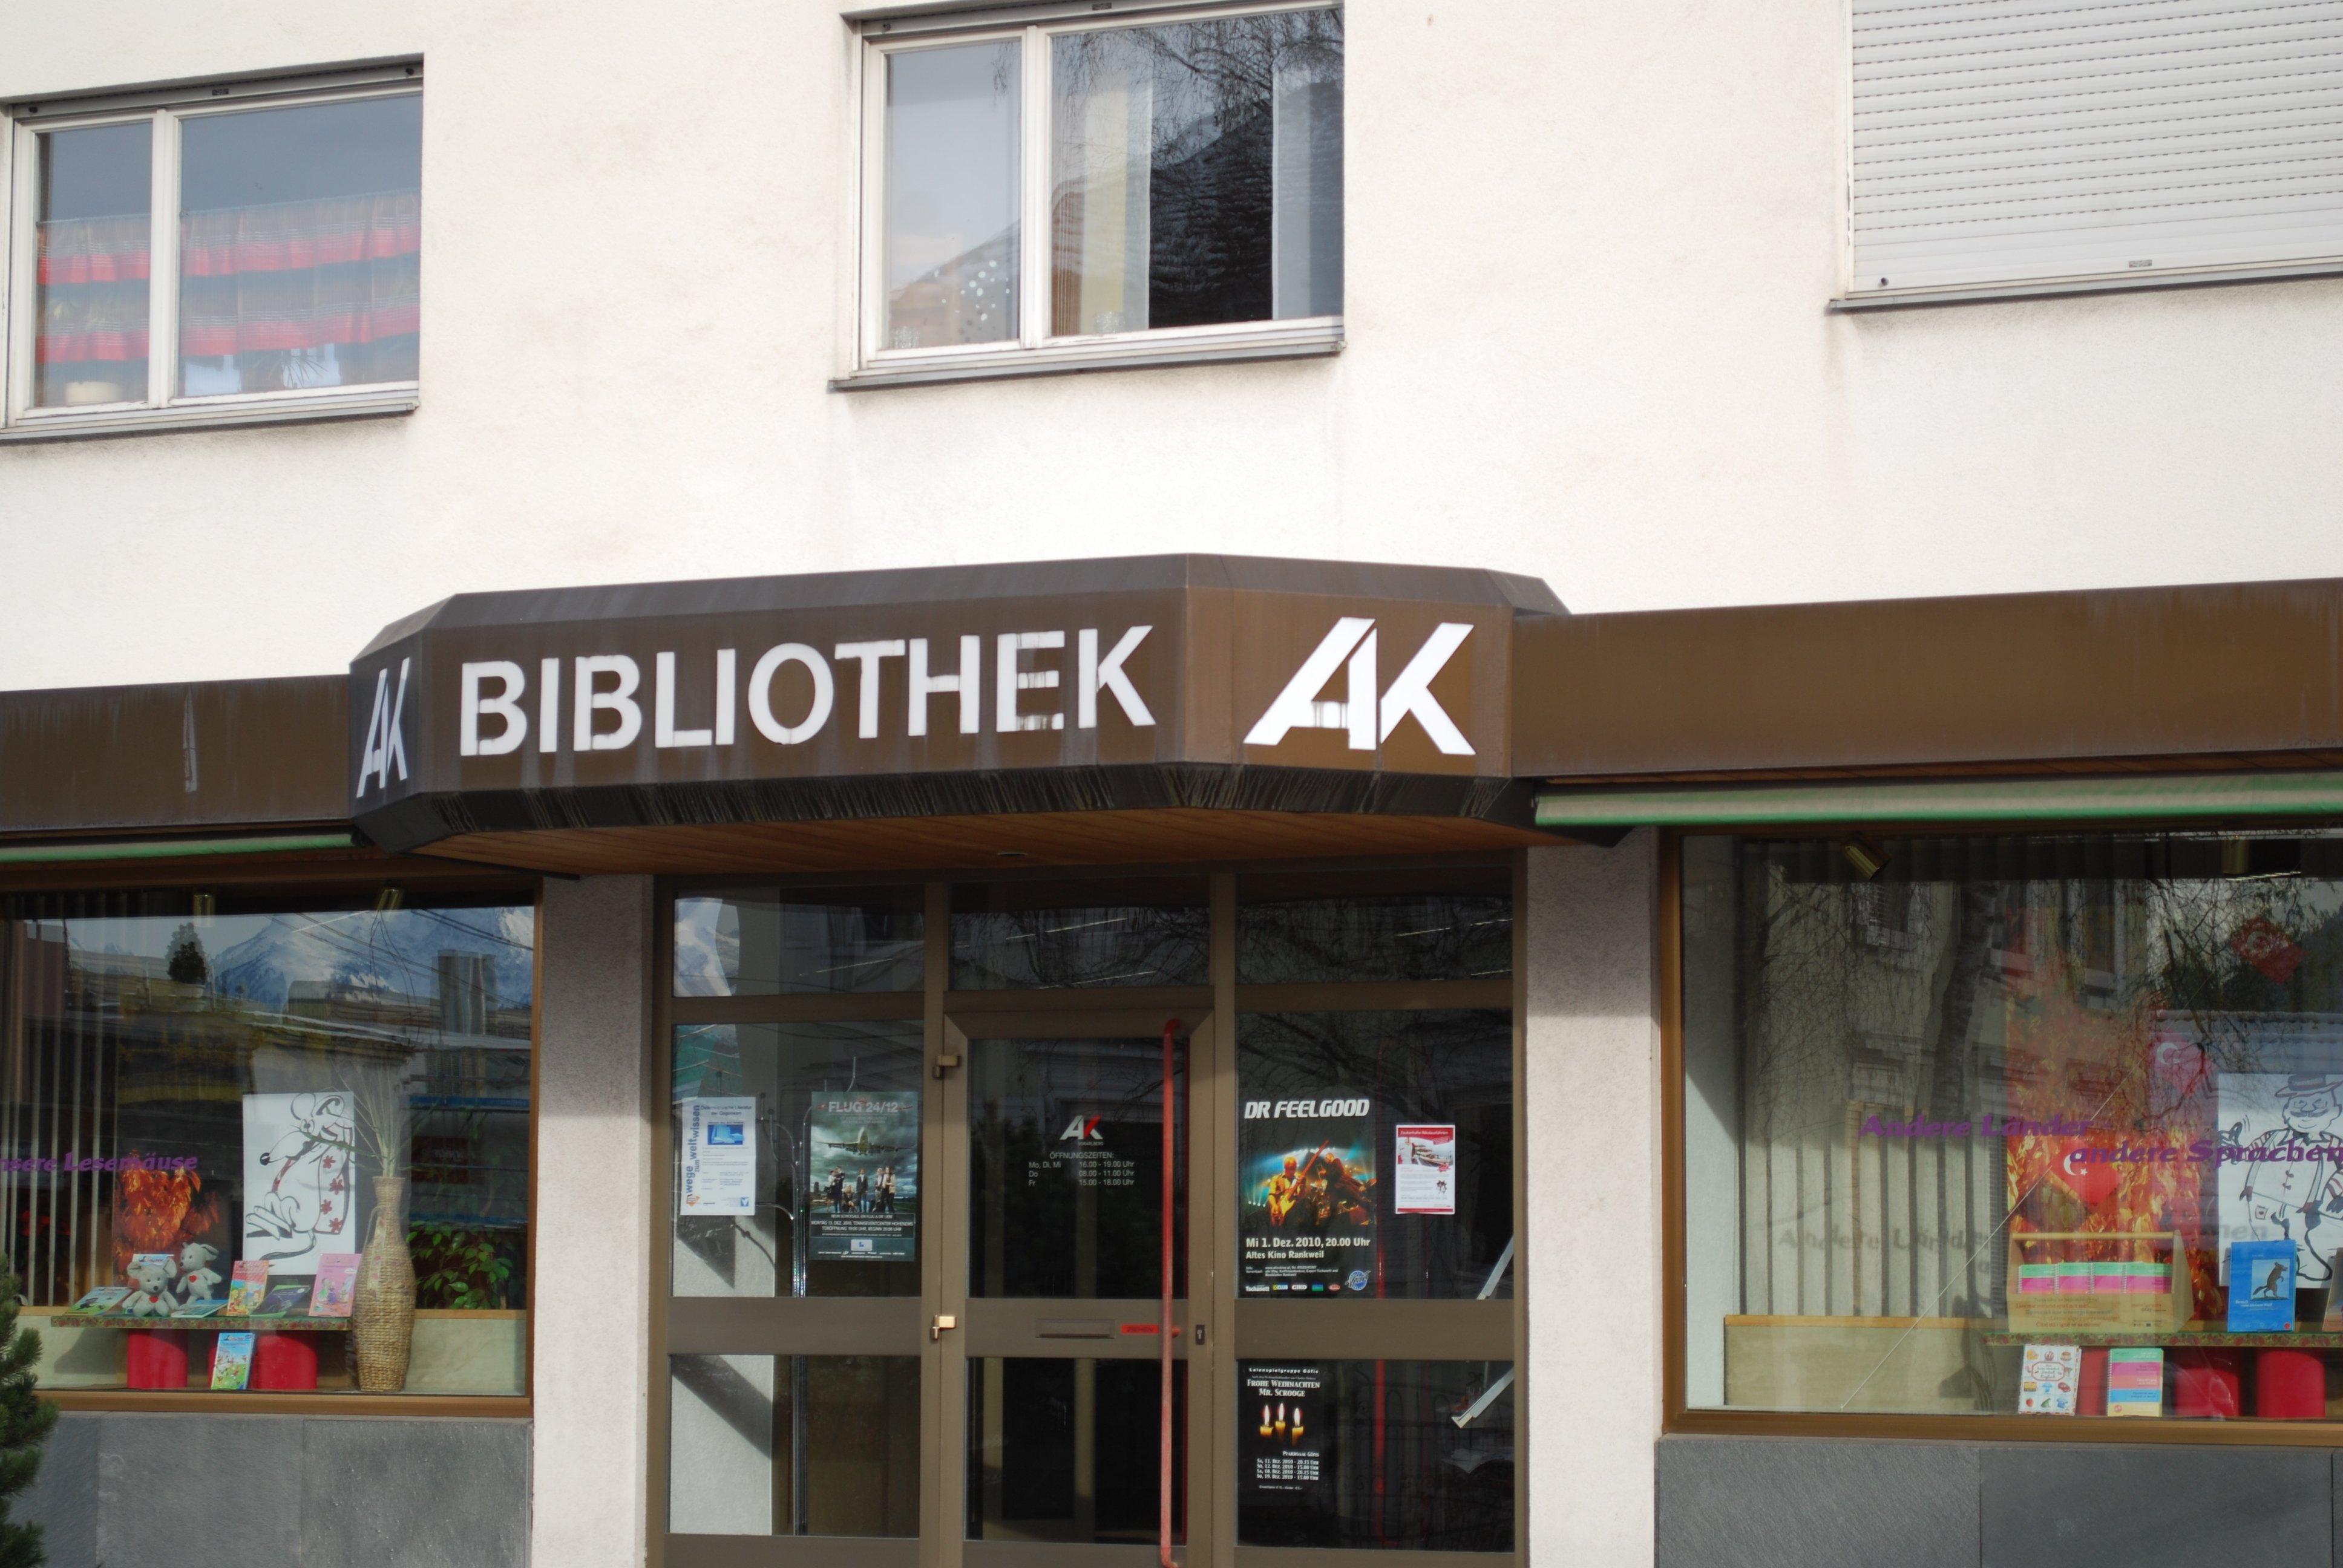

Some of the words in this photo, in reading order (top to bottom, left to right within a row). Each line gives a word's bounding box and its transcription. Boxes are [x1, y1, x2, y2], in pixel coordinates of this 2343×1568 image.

[459, 624, 1156, 757] BIBLIOTHEK
[1242, 616, 1476, 757] AK
[356, 655, 410, 799] AK
[828, 1102, 862, 1113] FLUG
[865, 1101, 899, 1113] 24/12
[1244, 1101, 1271, 1119] DR
[1274, 1099, 1370, 1119] FEELGOOD
[1060, 1113, 1104, 1140] AK
[1859, 1115, 1970, 1139] Andere
[64, 1151, 198, 1172] Lesemäuse
[1049, 1151, 1114, 1160] ÖFFNUNGSZEITEN:
[2069, 1138, 2178, 1164] andere
[2187, 1137, 2343, 1168] Sprachen
[1246, 1238, 1259, 1247] Mi
[1261, 1238, 1271, 1247] 1.
[1273, 1238, 1294, 1247] Dez.
[1296, 1237, 1324, 1248] 2010,
[1325, 1238, 1351, 1247] 20.00
[1353, 1237, 1371, 1246] Uhr
[1246, 1250, 1265, 1259] Altes
[1288, 1250, 1324, 1258] Rankweil
